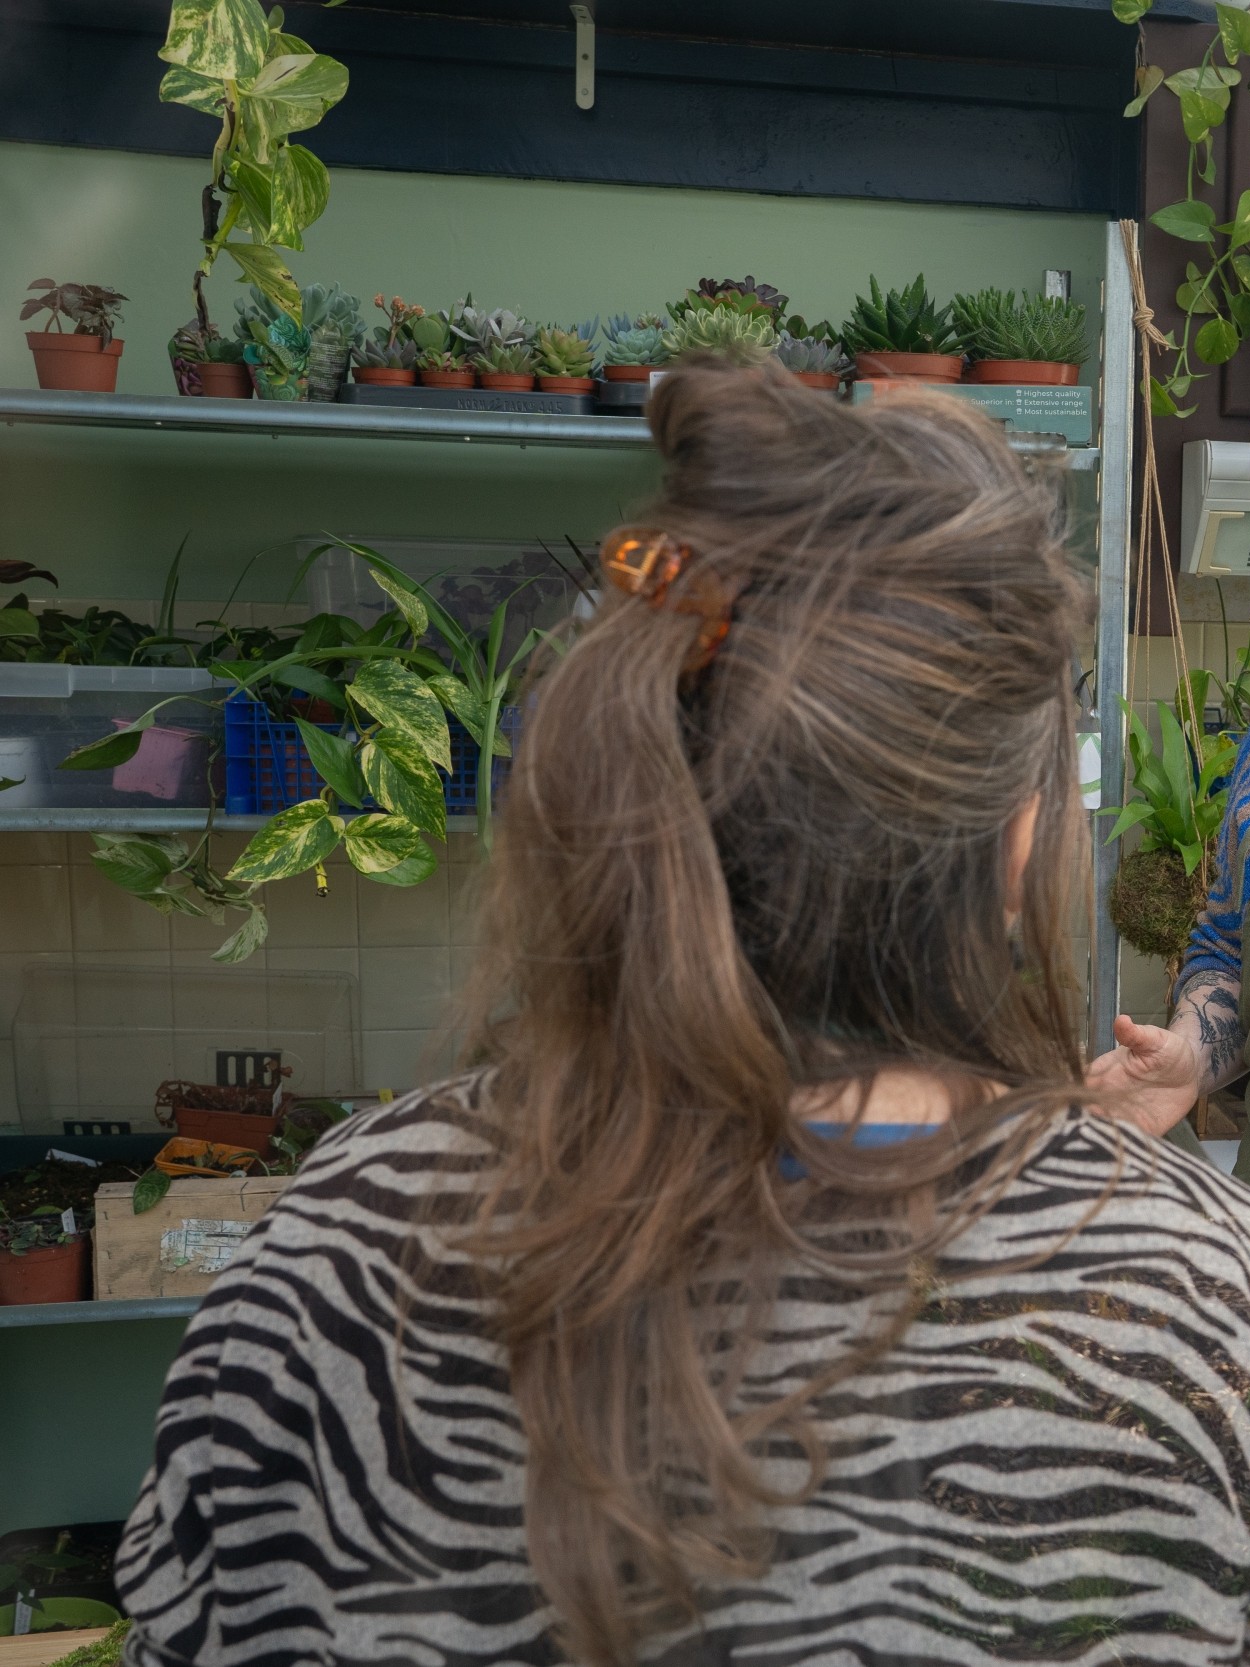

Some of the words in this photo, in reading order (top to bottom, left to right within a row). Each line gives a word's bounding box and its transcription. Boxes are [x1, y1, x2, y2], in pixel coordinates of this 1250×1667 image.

[1024, 389, 1053, 398] Highest
[1055, 390, 1081, 399] quality
[970, 398, 1003, 407] Superior
[1061, 400, 1084, 408] range
[1044, 408, 1088, 416] sustainable
